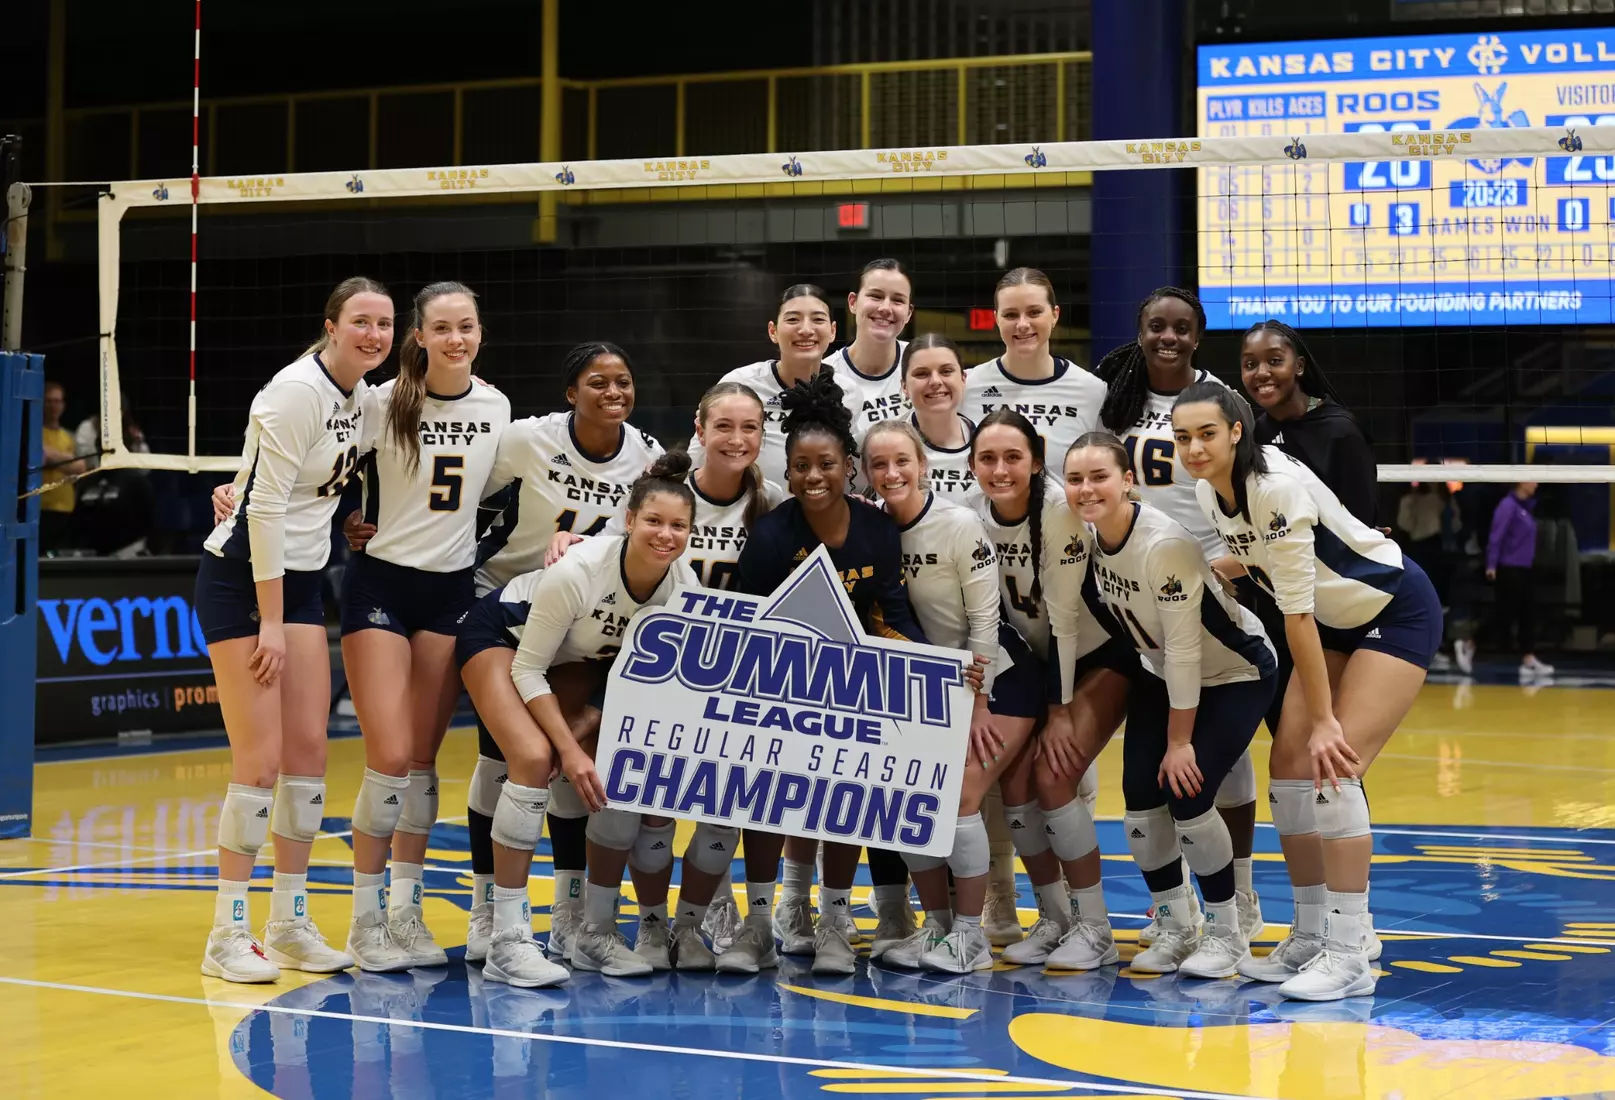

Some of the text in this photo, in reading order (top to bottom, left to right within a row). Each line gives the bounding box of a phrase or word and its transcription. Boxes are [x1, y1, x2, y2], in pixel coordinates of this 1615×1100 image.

[1209, 52, 1354, 78] KANSAS
[1370, 48, 1456, 71] CITY
[1208, 96, 1323, 119] PLYR KILLS ACES
[1337, 90, 1440, 114] ROOS
[1126, 142, 1201, 153] KANSAS
[1391, 133, 1472, 145] KANSAS
[876, 151, 947, 163] KANSAS
[1143, 152, 1186, 163] CITY
[1408, 144, 1455, 155] CITY
[427, 169, 488, 180] KANSAS
[644, 160, 709, 171] KANSAS
[893, 161, 932, 172] CITY
[440, 180, 475, 189] CITY
[658, 171, 697, 181] CITY
[1463, 180, 1518, 206] 20:23
[1396, 205, 1414, 234] 3
[1428, 217, 1494, 235] GAMES
[1504, 215, 1550, 232] WON
[1565, 199, 1583, 230] 0
[1229, 290, 1582, 315] THANK YOU TO OUR FOUNDING PARTNERS
[862, 393, 902, 411] ANS
[419, 422, 491, 433] ANSAS
[1029, 416, 1057, 426] TY
[423, 434, 475, 446] CITY
[1123, 433, 1176, 487] 16
[428, 454, 465, 513] 5
[932, 469, 976, 480] NSA
[936, 481, 972, 492] ITY
[566, 489, 622, 507] CITY
[690, 525, 748, 538] ANSA
[690, 537, 745, 551] CITY
[996, 543, 1031, 554] NSA
[1000, 555, 1028, 567] ITY
[1060, 553, 1087, 565] ROOS
[1094, 561, 1140, 592] KANSAS
[1005, 574, 1040, 619] 4
[1104, 580, 1130, 601] CITY
[681, 591, 759, 623] THE
[590, 609, 630, 627] KAN
[1111, 602, 1160, 649] 11
[601, 624, 624, 637] CI
[620, 613, 964, 728] SUMMIT
[91, 689, 159, 716] graphics
[703, 697, 881, 746] LEAGUE
[618, 716, 948, 790] REGULAR SEASON
[605, 747, 941, 848] CHAMPIONS
